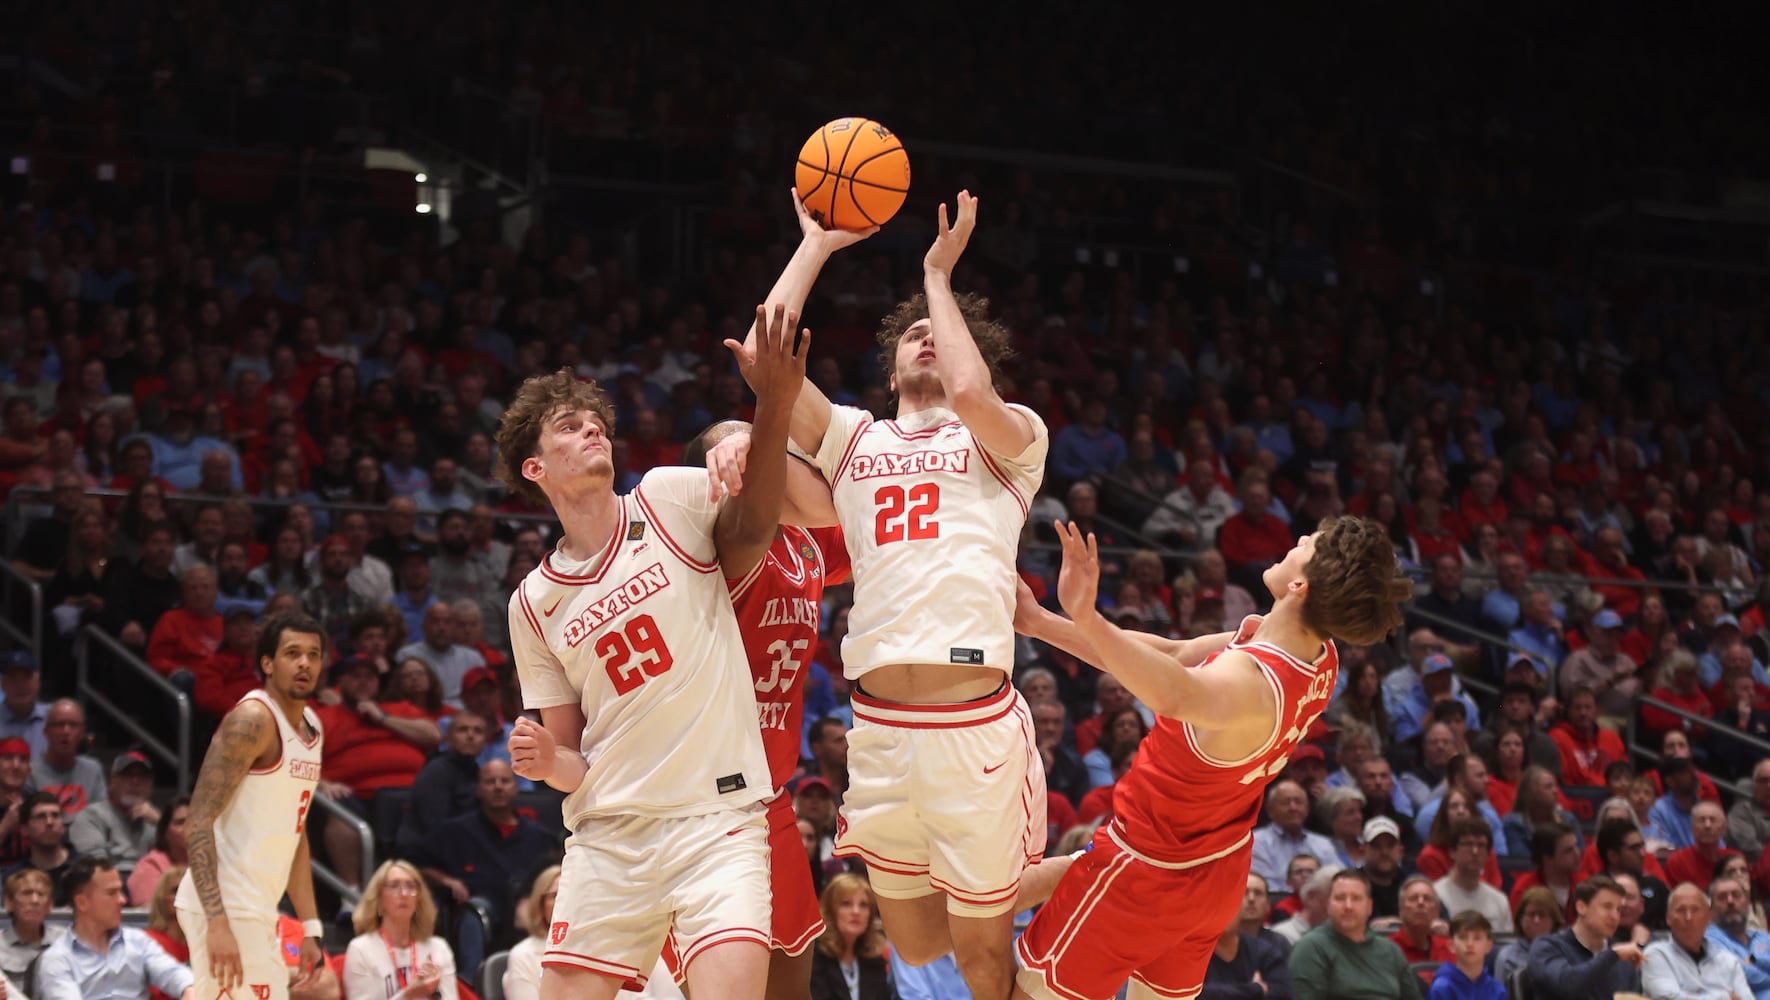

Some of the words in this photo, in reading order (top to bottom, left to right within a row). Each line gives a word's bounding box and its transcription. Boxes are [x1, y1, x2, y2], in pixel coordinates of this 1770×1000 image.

[850, 448, 970, 482] DAYTON
[874, 482, 940, 546] 22
[564, 562, 671, 648] DAYTON
[594, 613, 674, 697] 29
[755, 638, 809, 693] 35
